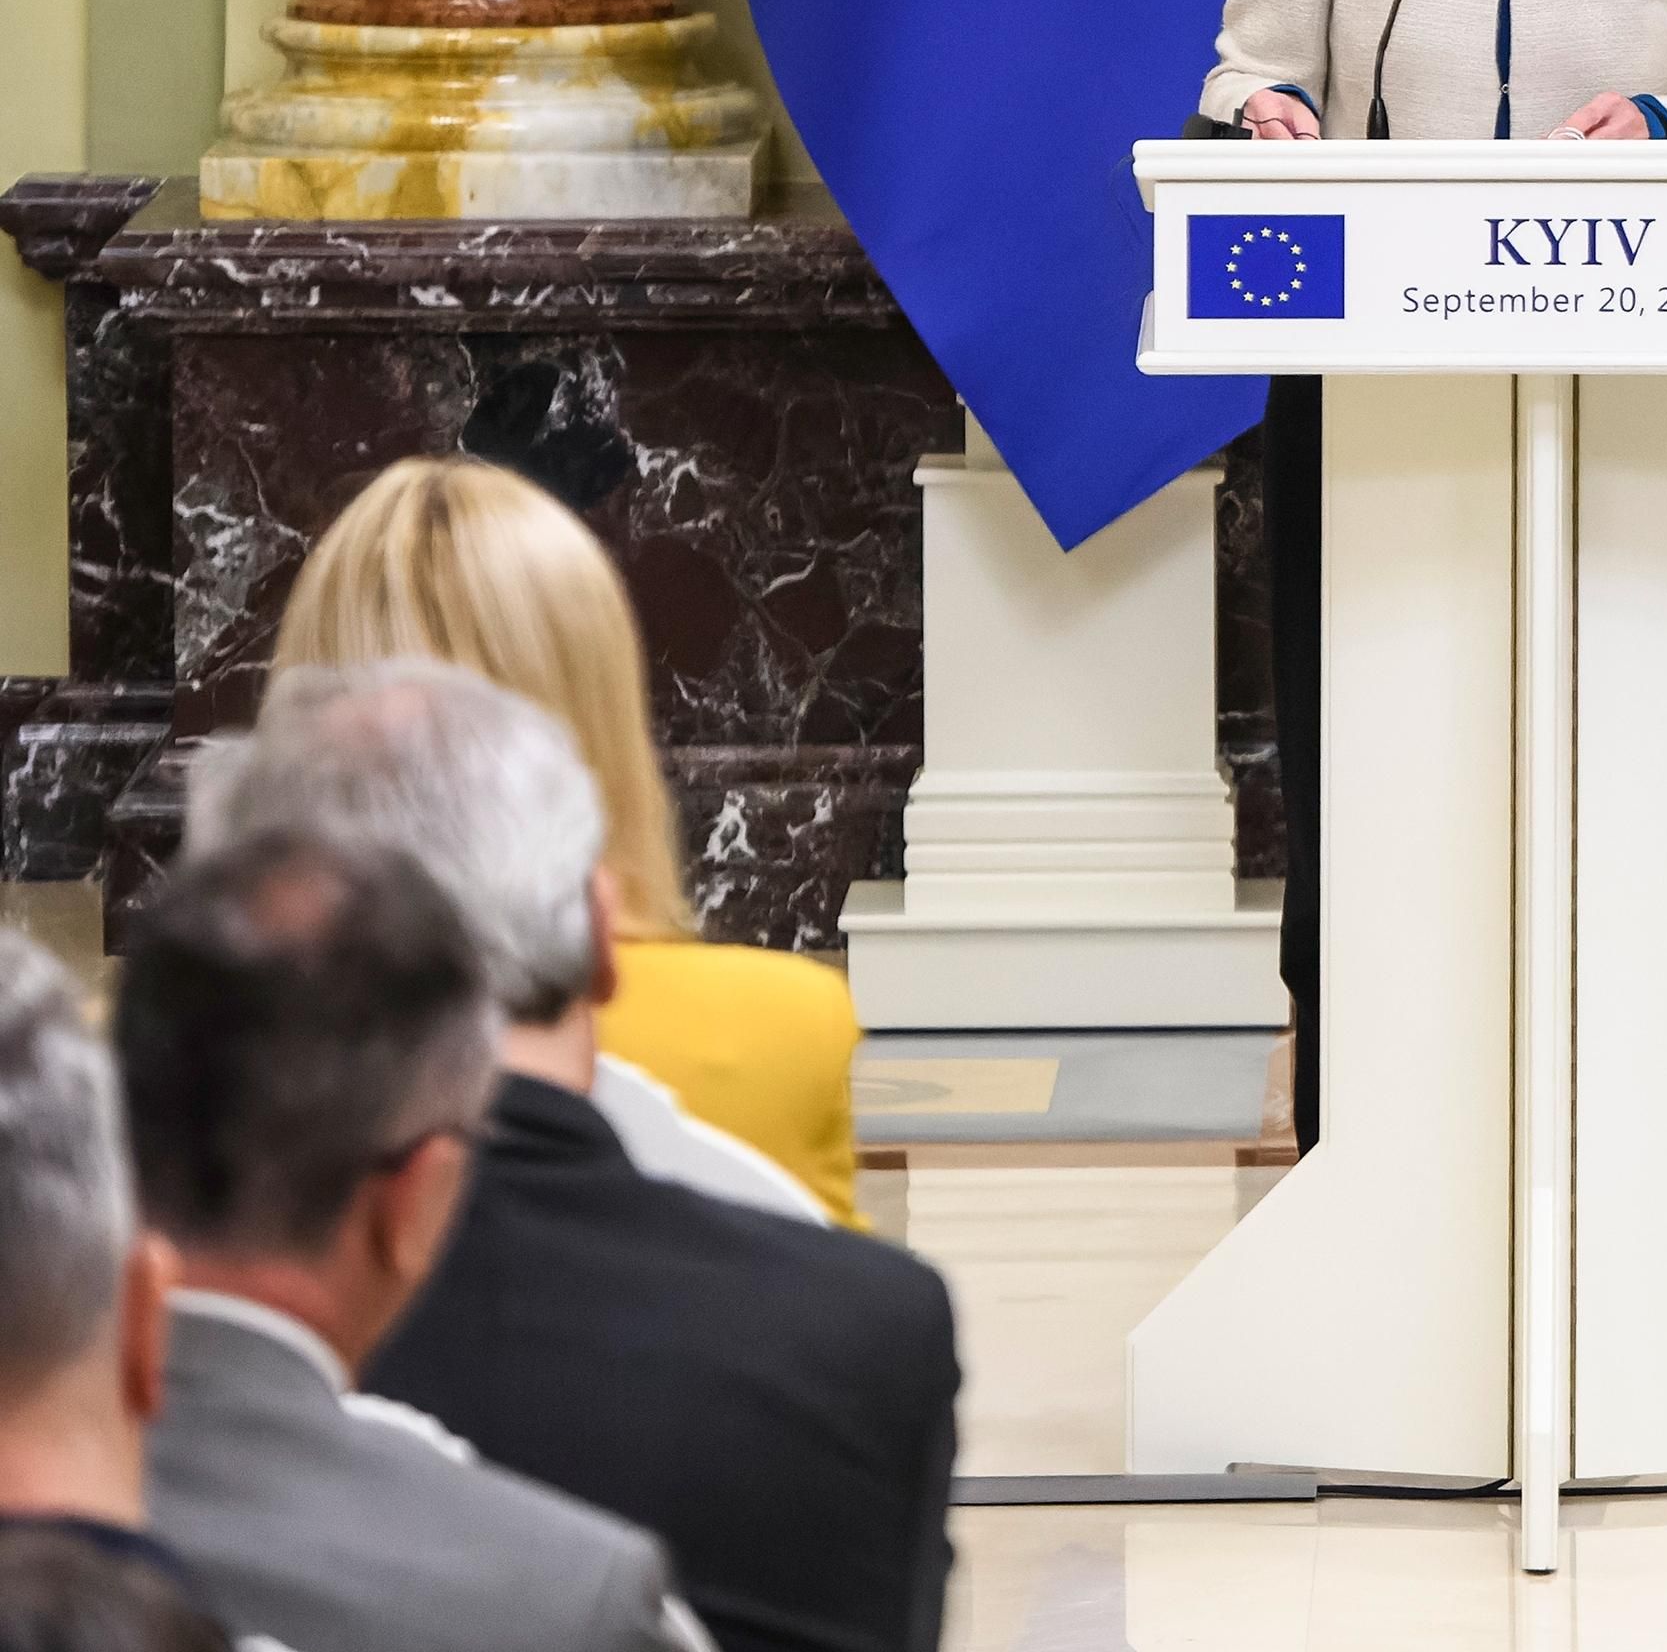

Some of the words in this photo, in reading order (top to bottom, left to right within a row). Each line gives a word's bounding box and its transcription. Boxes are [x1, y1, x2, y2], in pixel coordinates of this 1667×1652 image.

[1483, 217, 1658, 268] KYIV
[1402, 284, 1586, 322] September
[1597, 285, 1646, 318] 20,
